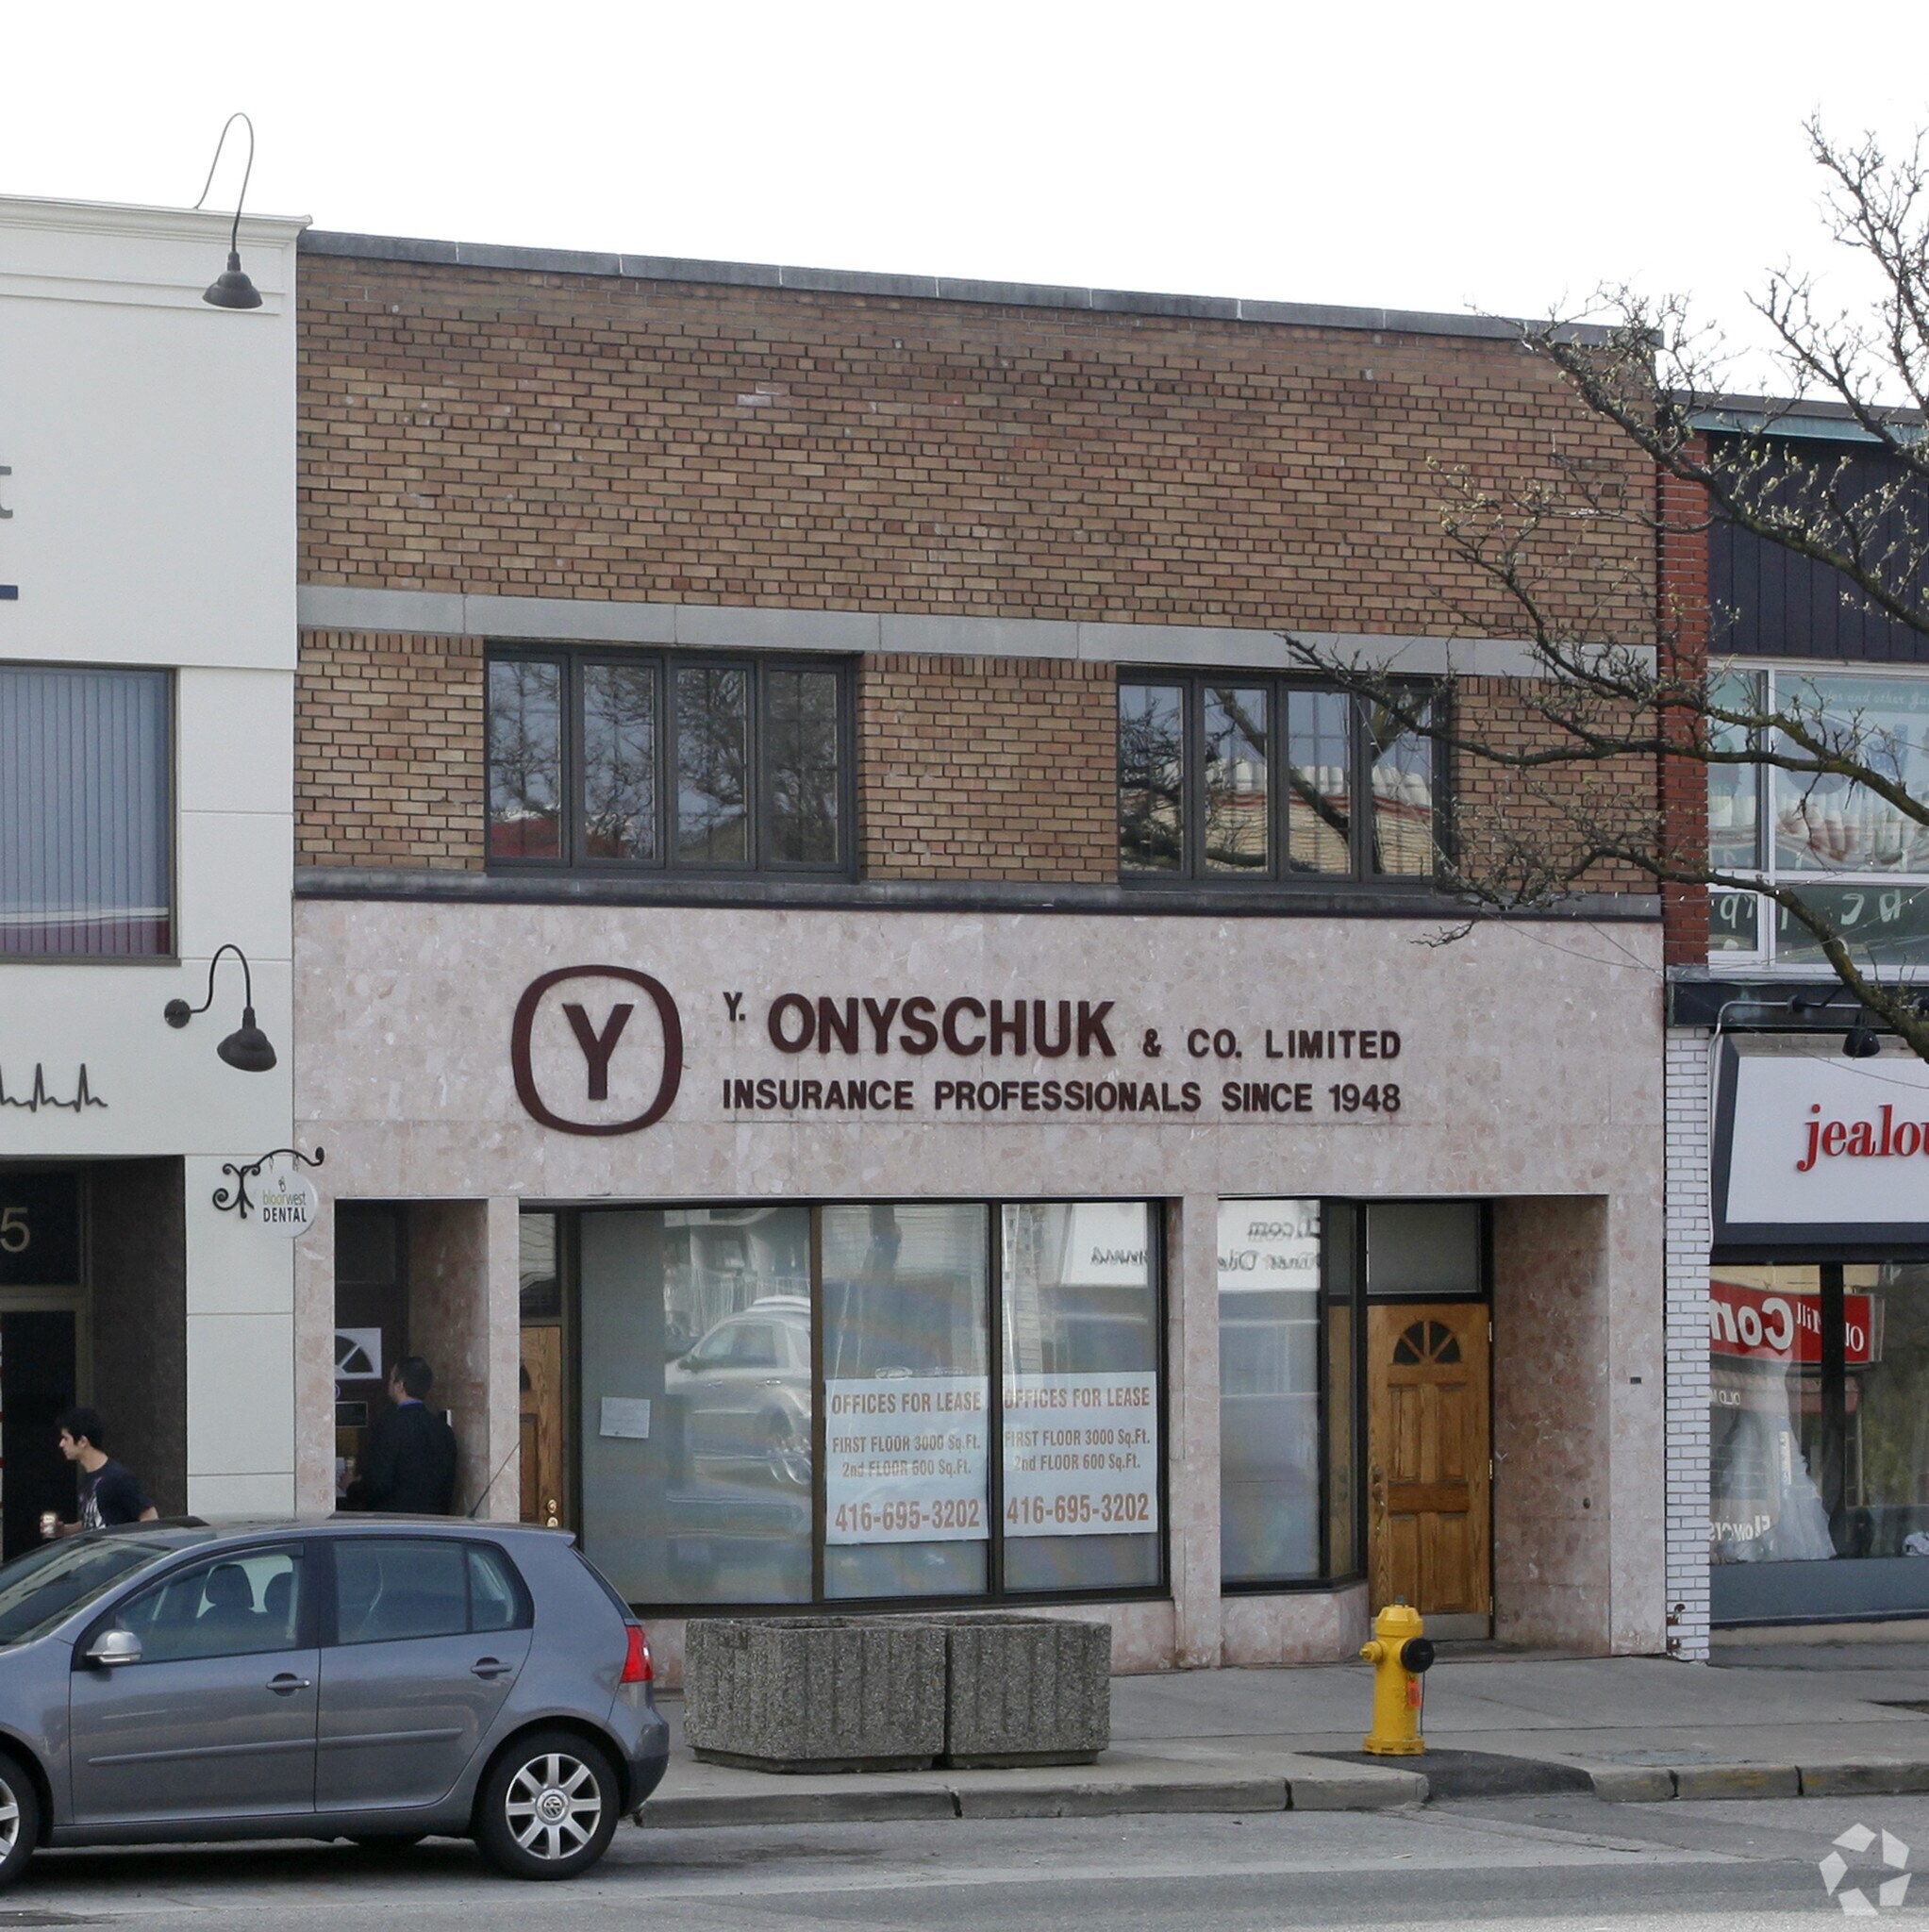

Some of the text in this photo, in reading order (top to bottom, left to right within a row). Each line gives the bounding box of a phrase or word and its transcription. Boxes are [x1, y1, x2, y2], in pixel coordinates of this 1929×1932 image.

[723, 991, 1401, 1059] Y. ONYSCHUK & CO. LIMITED
[723, 1078, 1401, 1112] INSURANCE PROFESSIONALS SINCE 1948
[1796, 1103, 1929, 1172] jealo
[262, 1190, 307, 1206] bloorwest
[263, 1208, 308, 1223] DENTAL
[0, 1207, 30, 1254] 5
[832, 1391, 981, 1414] OFFICES FOR LEASE
[1005, 1387, 1150, 1408] OFFICES FOR LEASE
[833, 1437, 866, 1453] FIRST
[871, 1435, 910, 1452] FLOOR
[914, 1435, 944, 1451] 3000
[1005, 1428, 1151, 1448] FIRST FLOOR 3000 Sq.Ft.
[842, 1462, 864, 1477] 2nd
[869, 1460, 908, 1476] FLOOR
[912, 1459, 935, 1475] 600
[1015, 1453, 1140, 1473] 2nd FLOOR 600 Sq.Ft.
[835, 1499, 980, 1531] 416-695-3202
[1006, 1492, 1149, 1524] 416-695-3202
